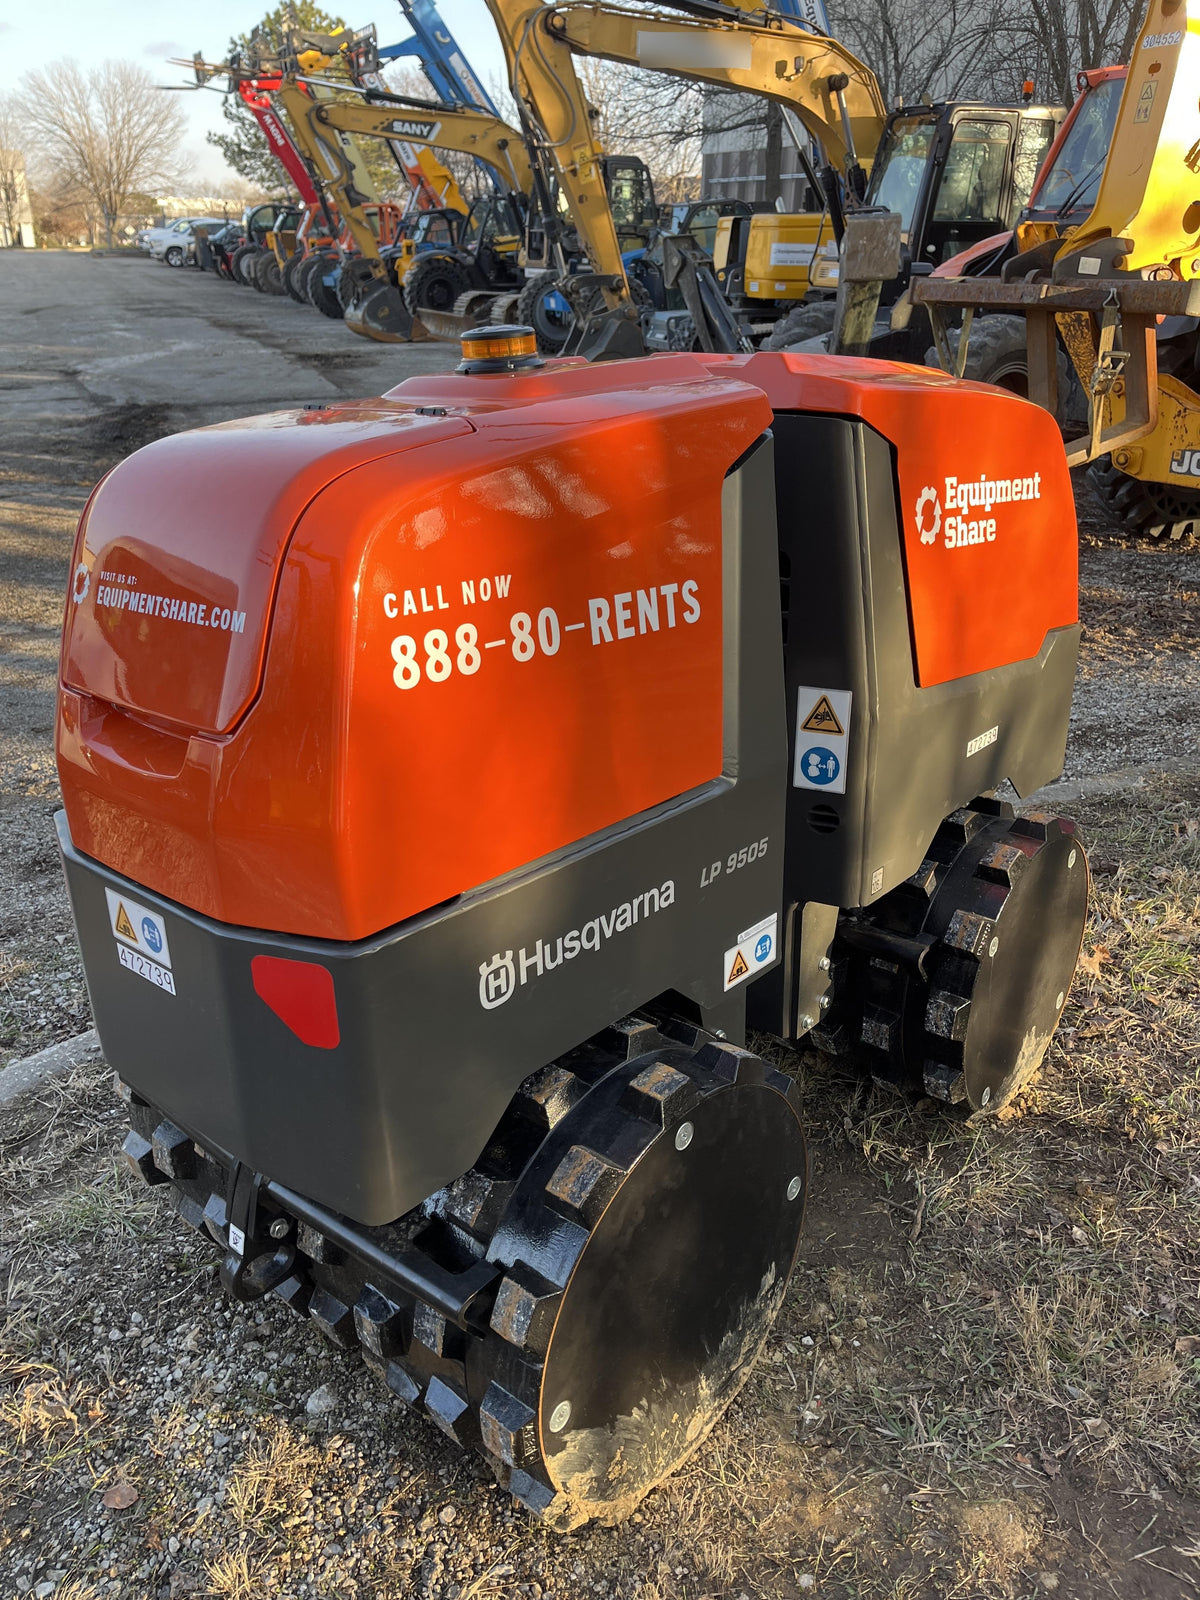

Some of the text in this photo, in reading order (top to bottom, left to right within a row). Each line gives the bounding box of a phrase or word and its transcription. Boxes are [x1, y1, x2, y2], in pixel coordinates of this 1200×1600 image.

[1143, 31, 1182, 48] 304552
[263, 114, 286, 146] MAGNI
[392, 121, 431, 136] SANY
[944, 472, 1041, 515] Equipment
[944, 516, 997, 549] Share
[100, 571, 138, 585] VISIT US AT:
[383, 574, 512, 619] CALL NOW
[96, 585, 247, 633] EQUIPMENTSHARE.COM
[390, 579, 702, 690] 888-80-RENTS
[700, 837, 769, 888] LP 9505
[519, 880, 675, 986] Husqvarna
[120, 947, 174, 993] 472739
